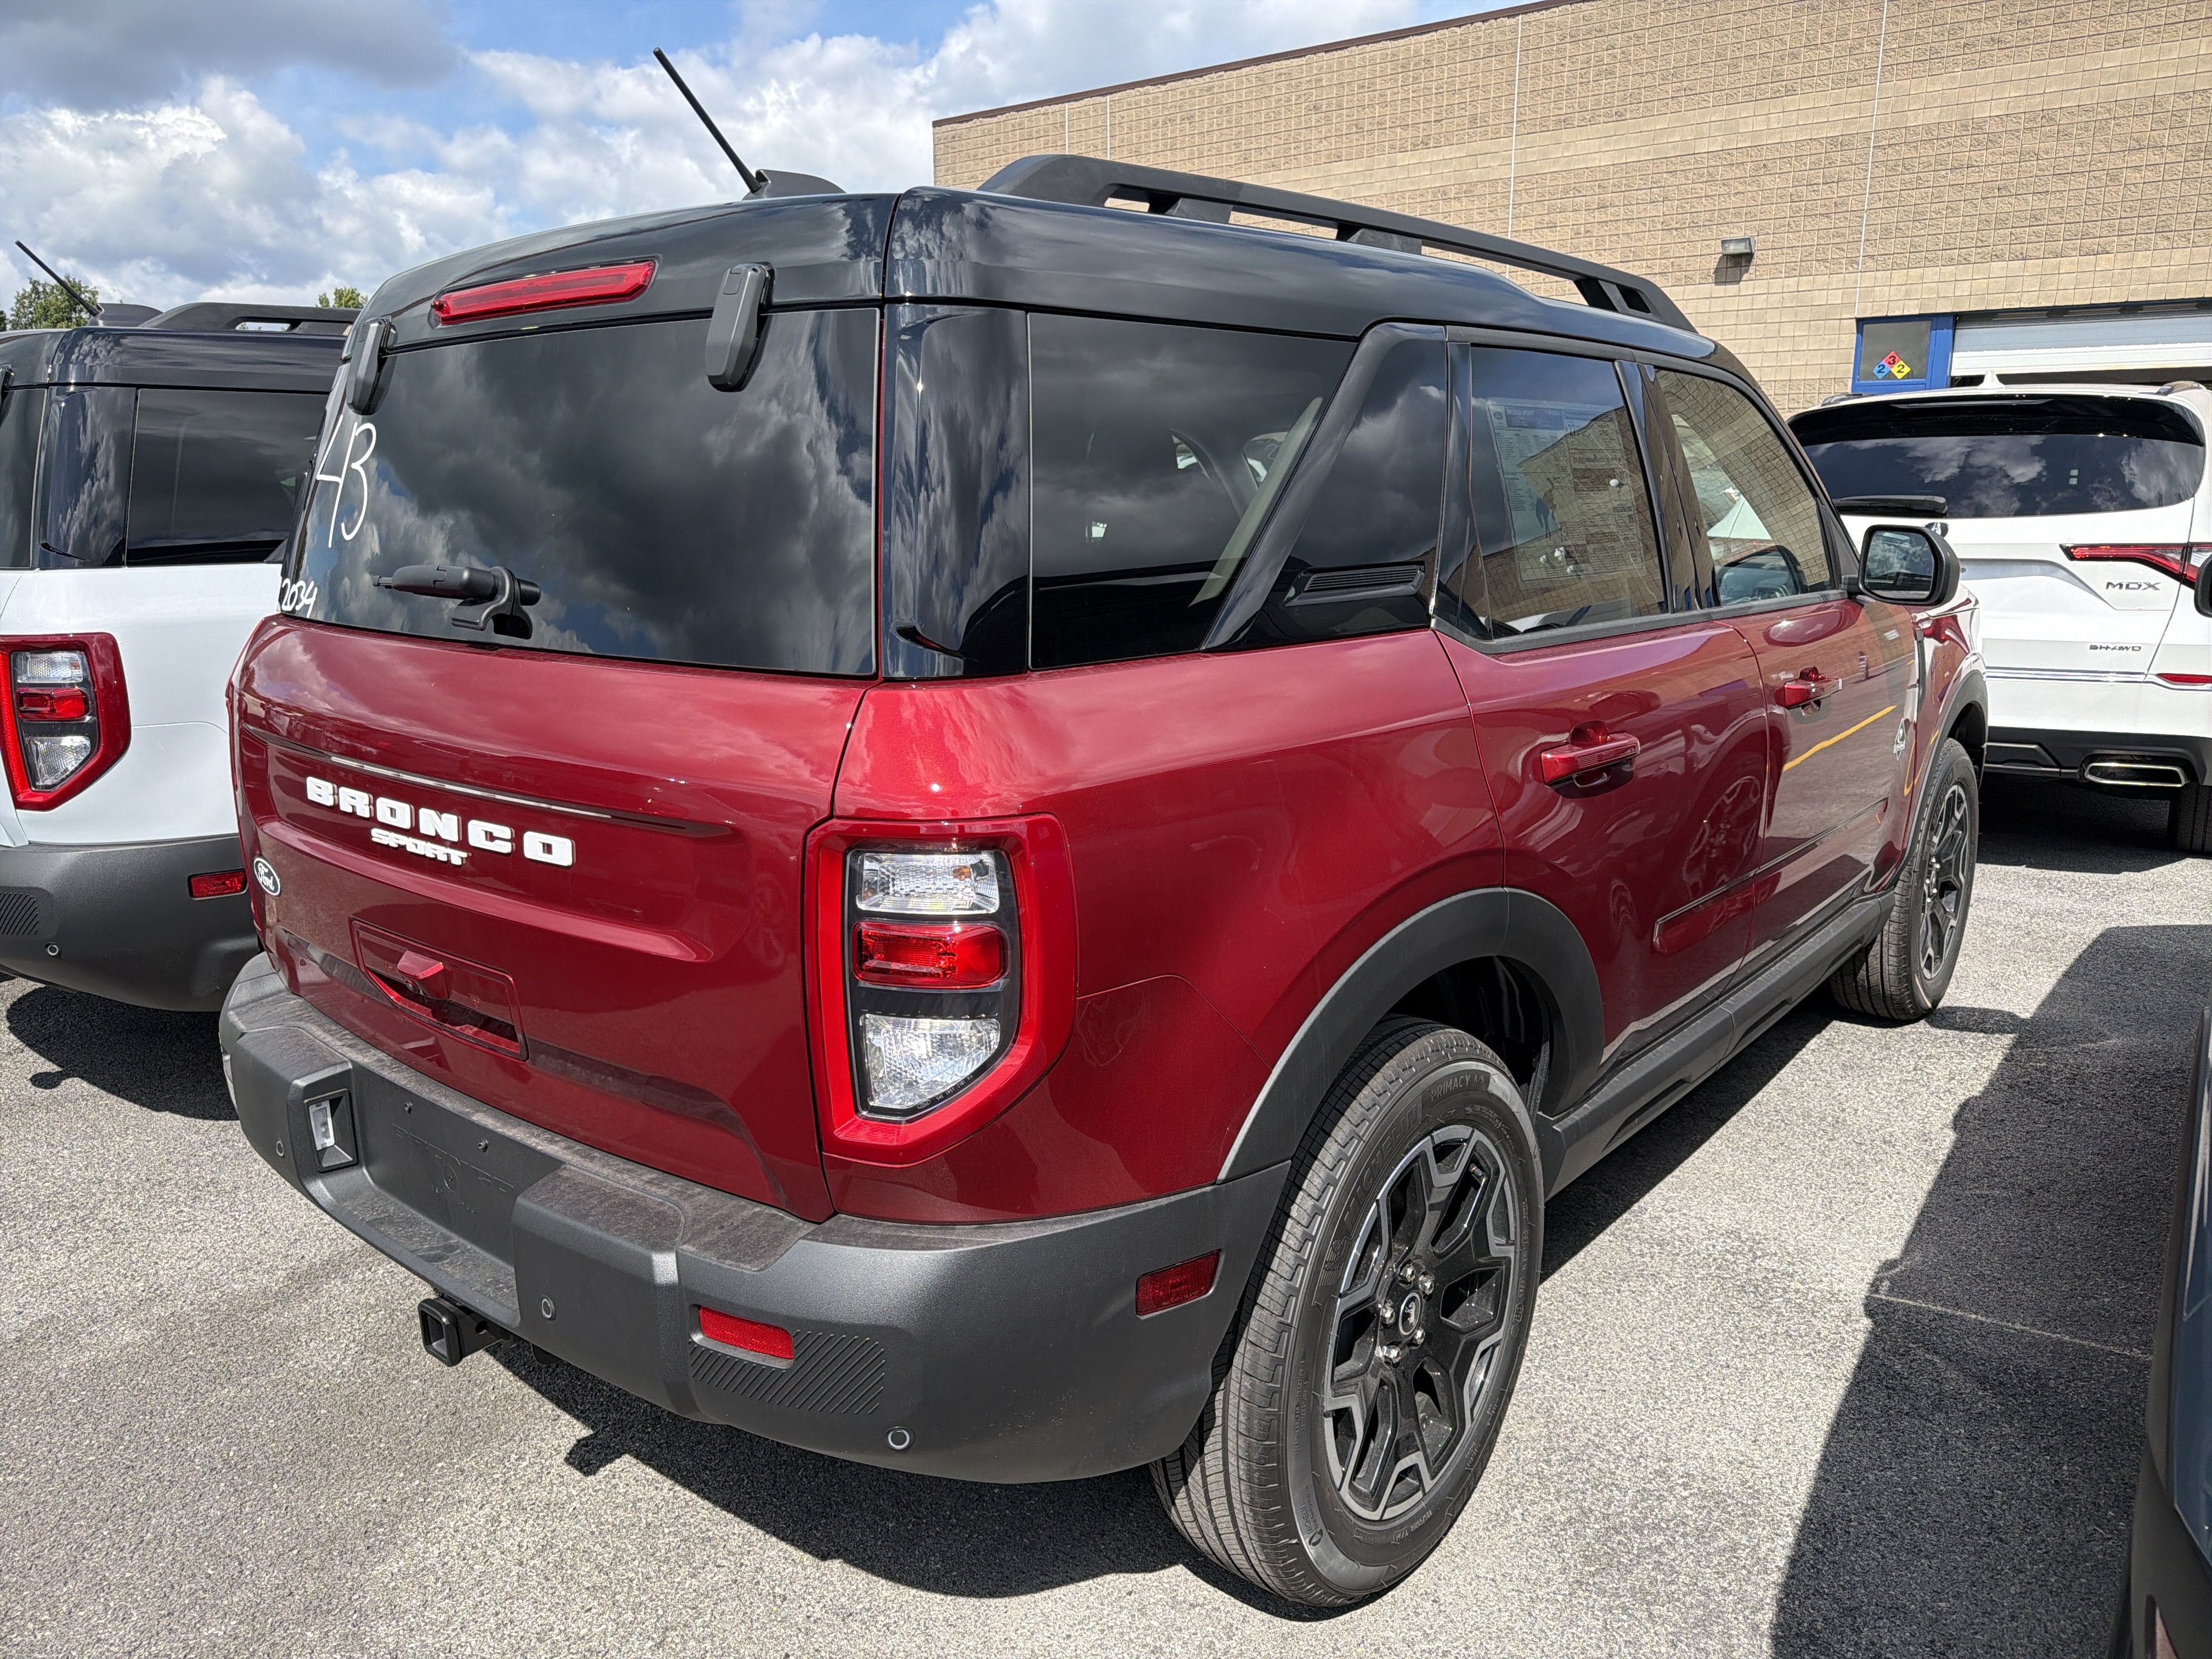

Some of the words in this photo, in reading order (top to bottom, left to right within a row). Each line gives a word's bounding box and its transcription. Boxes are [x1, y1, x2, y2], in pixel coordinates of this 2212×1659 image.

[1877, 364, 1886, 374] 2
[1897, 364, 1905, 373] 2
[1888, 356, 1896, 365] 3
[281, 578, 318, 618] 2034
[2105, 581, 2163, 591] MDX
[306, 776, 576, 867] BRONCO
[371, 827, 472, 866] SPORT
[1430, 1075, 1471, 1102] PRIMACY
